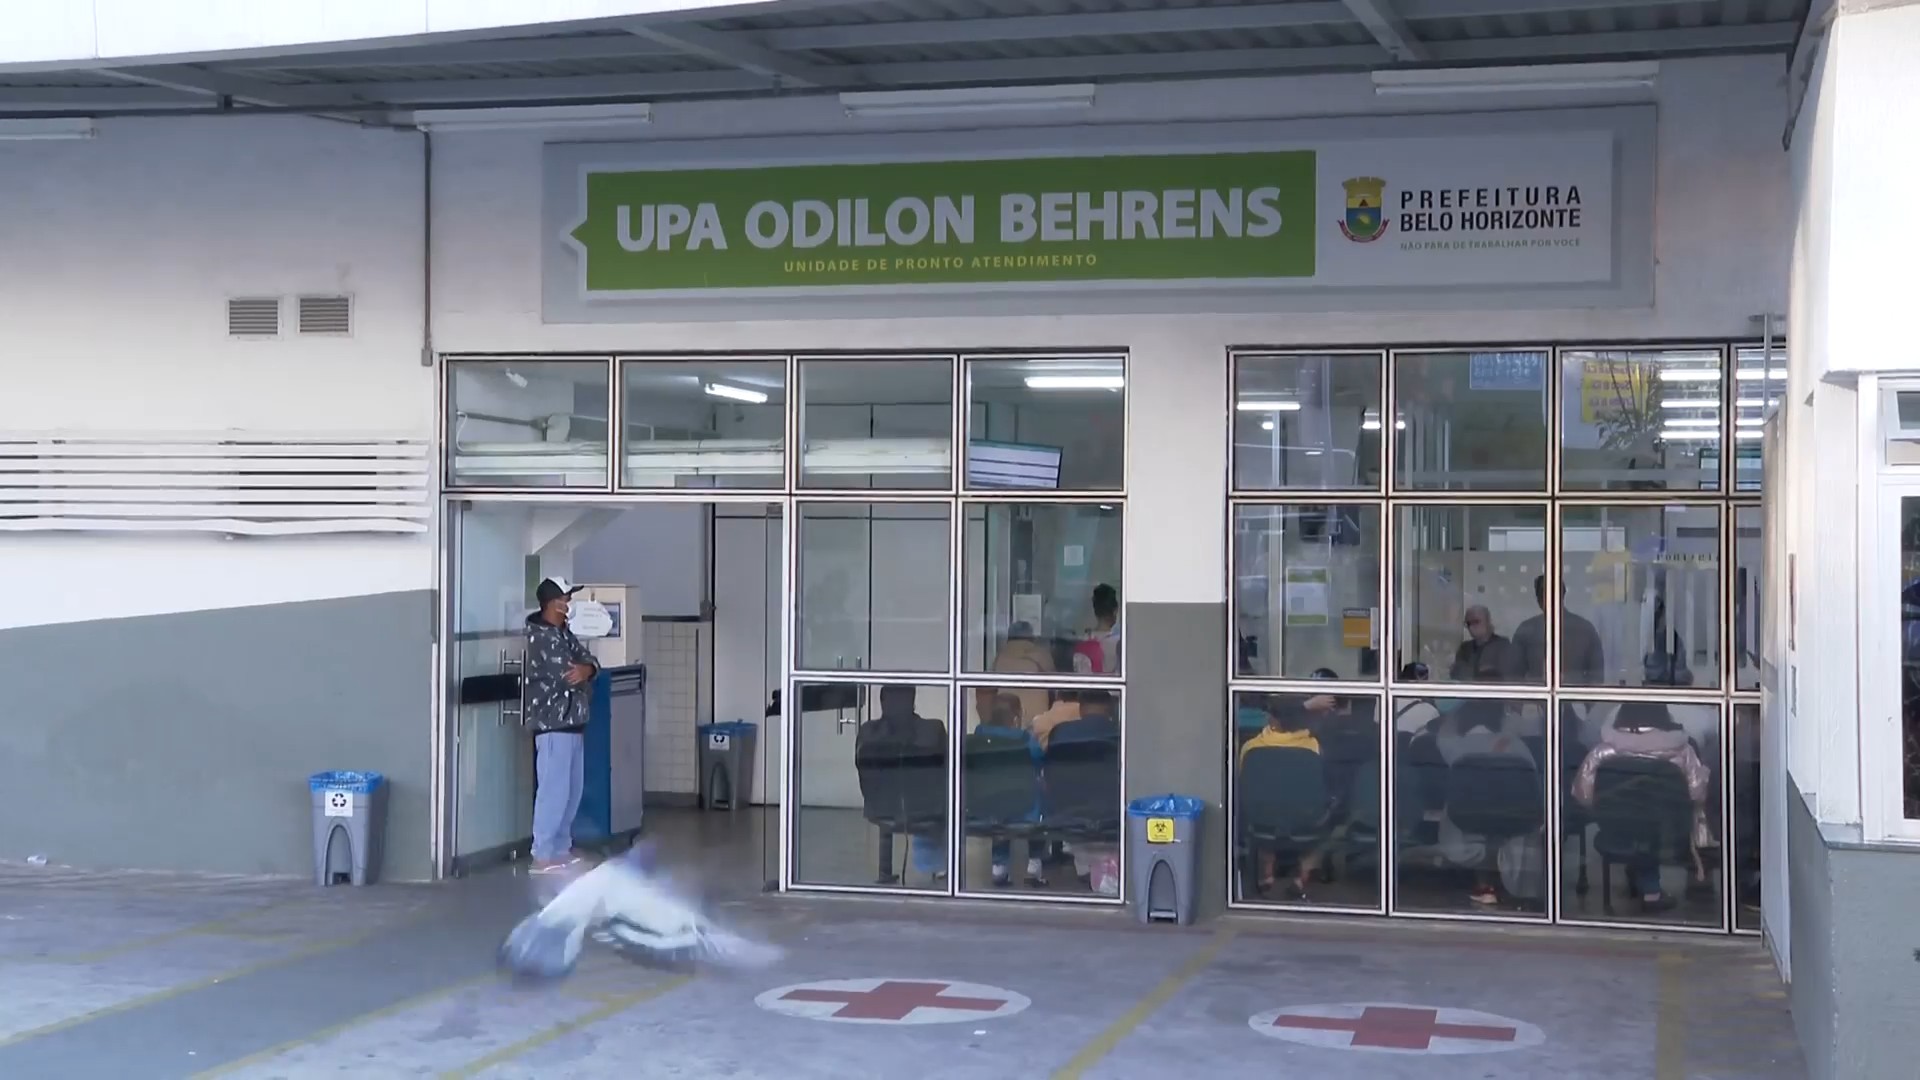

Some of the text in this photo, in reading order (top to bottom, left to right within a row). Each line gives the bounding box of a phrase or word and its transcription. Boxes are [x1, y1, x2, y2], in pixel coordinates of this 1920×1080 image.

[1400, 186, 1581, 209] PREFEITURA
[616, 187, 1282, 252] UPA ODILON BEHRENS
[1400, 207, 1581, 232] BELO HORIZONTE
[1424, 240, 1450, 250] PARA
[1453, 239, 1466, 249] DE
[1468, 239, 1528, 249] TRABALHAR
[1553, 236, 1581, 247] VOCÊ
[784, 254, 1097, 273] UNIDADE DE PRONTO ATENDIMENTO
